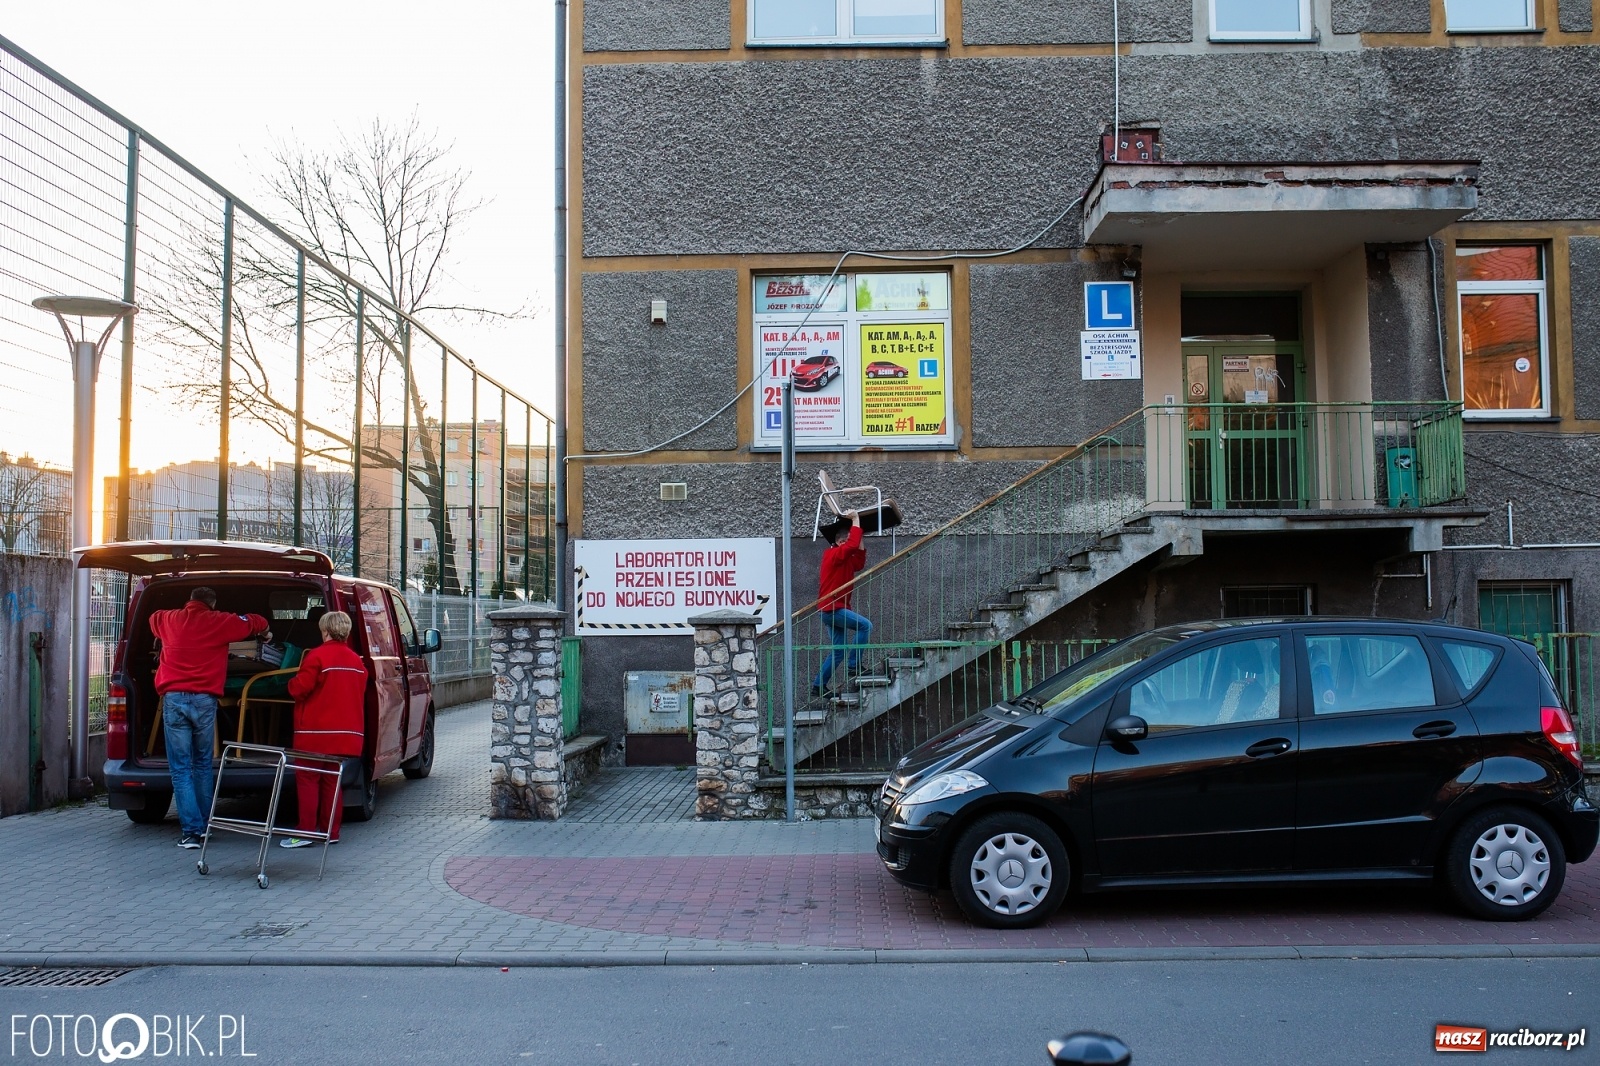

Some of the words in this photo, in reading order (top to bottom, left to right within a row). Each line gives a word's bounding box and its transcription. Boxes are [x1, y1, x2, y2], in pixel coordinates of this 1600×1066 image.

[1102, 290, 1122, 319] L
[764, 333, 780, 342] KAT.
[826, 332, 840, 341] AM
[868, 332, 884, 340] KAT.
[887, 331, 901, 341] AM,
[918, 343, 934, 352] C+E
[924, 362, 934, 375] L
[814, 397, 840, 405] RYNKU!
[895, 416, 914, 432] #1
[615, 551, 736, 568] LABORATORIUM
[615, 570, 736, 588] PRZENIESIONE
[586, 592, 605, 608] DO
[616, 591, 675, 607] NOWEGO
[685, 590, 755, 606] BUDYNKU
